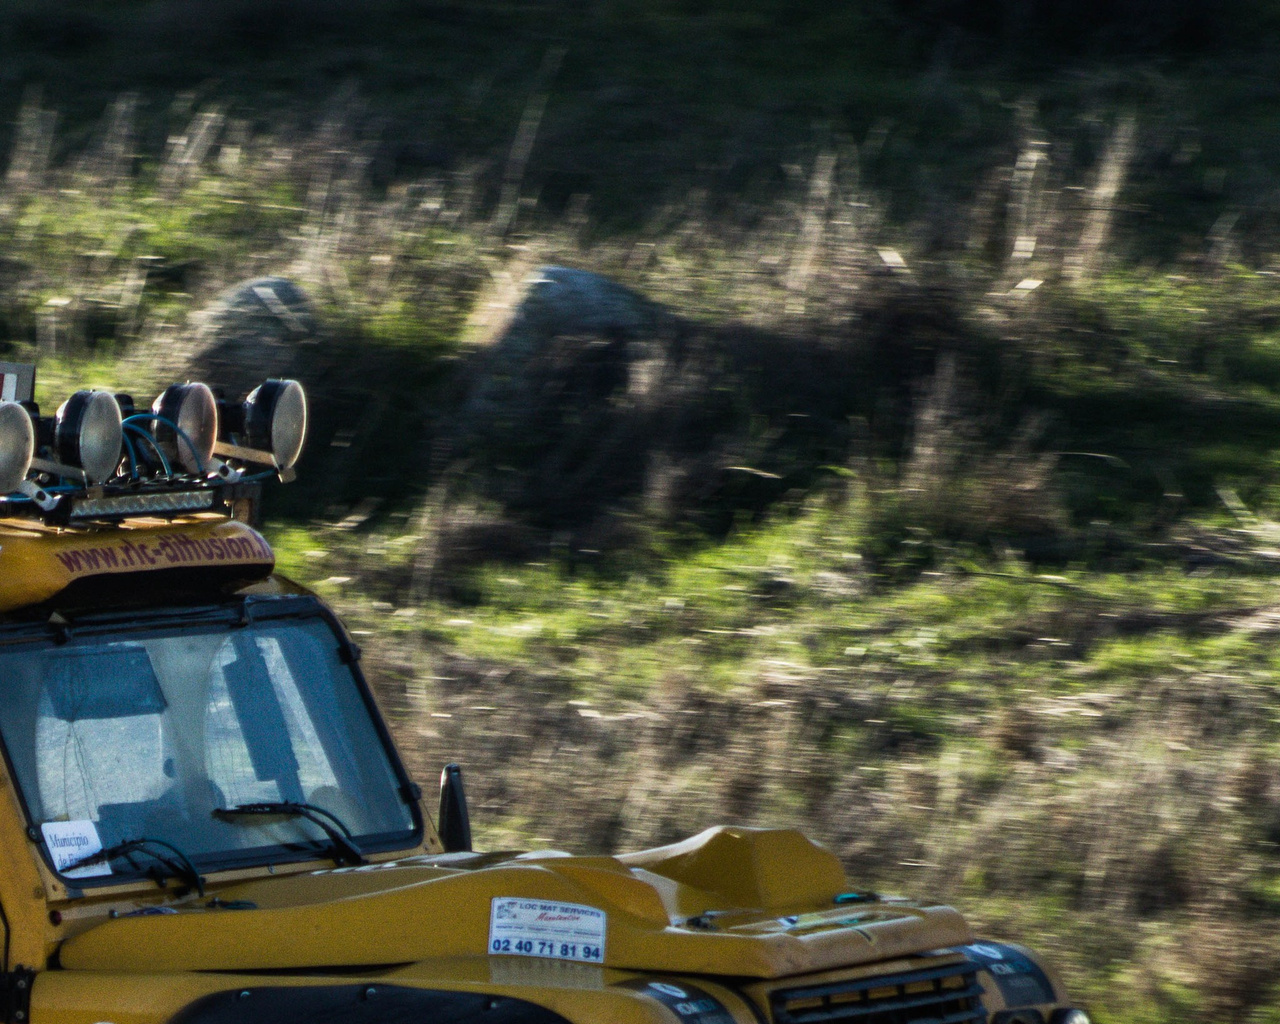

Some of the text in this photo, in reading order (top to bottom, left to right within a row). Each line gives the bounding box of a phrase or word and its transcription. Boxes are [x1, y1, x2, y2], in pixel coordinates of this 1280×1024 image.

[520, 903, 538, 911] LOC
[493, 939, 600, 959] 02 40 71 81 94
